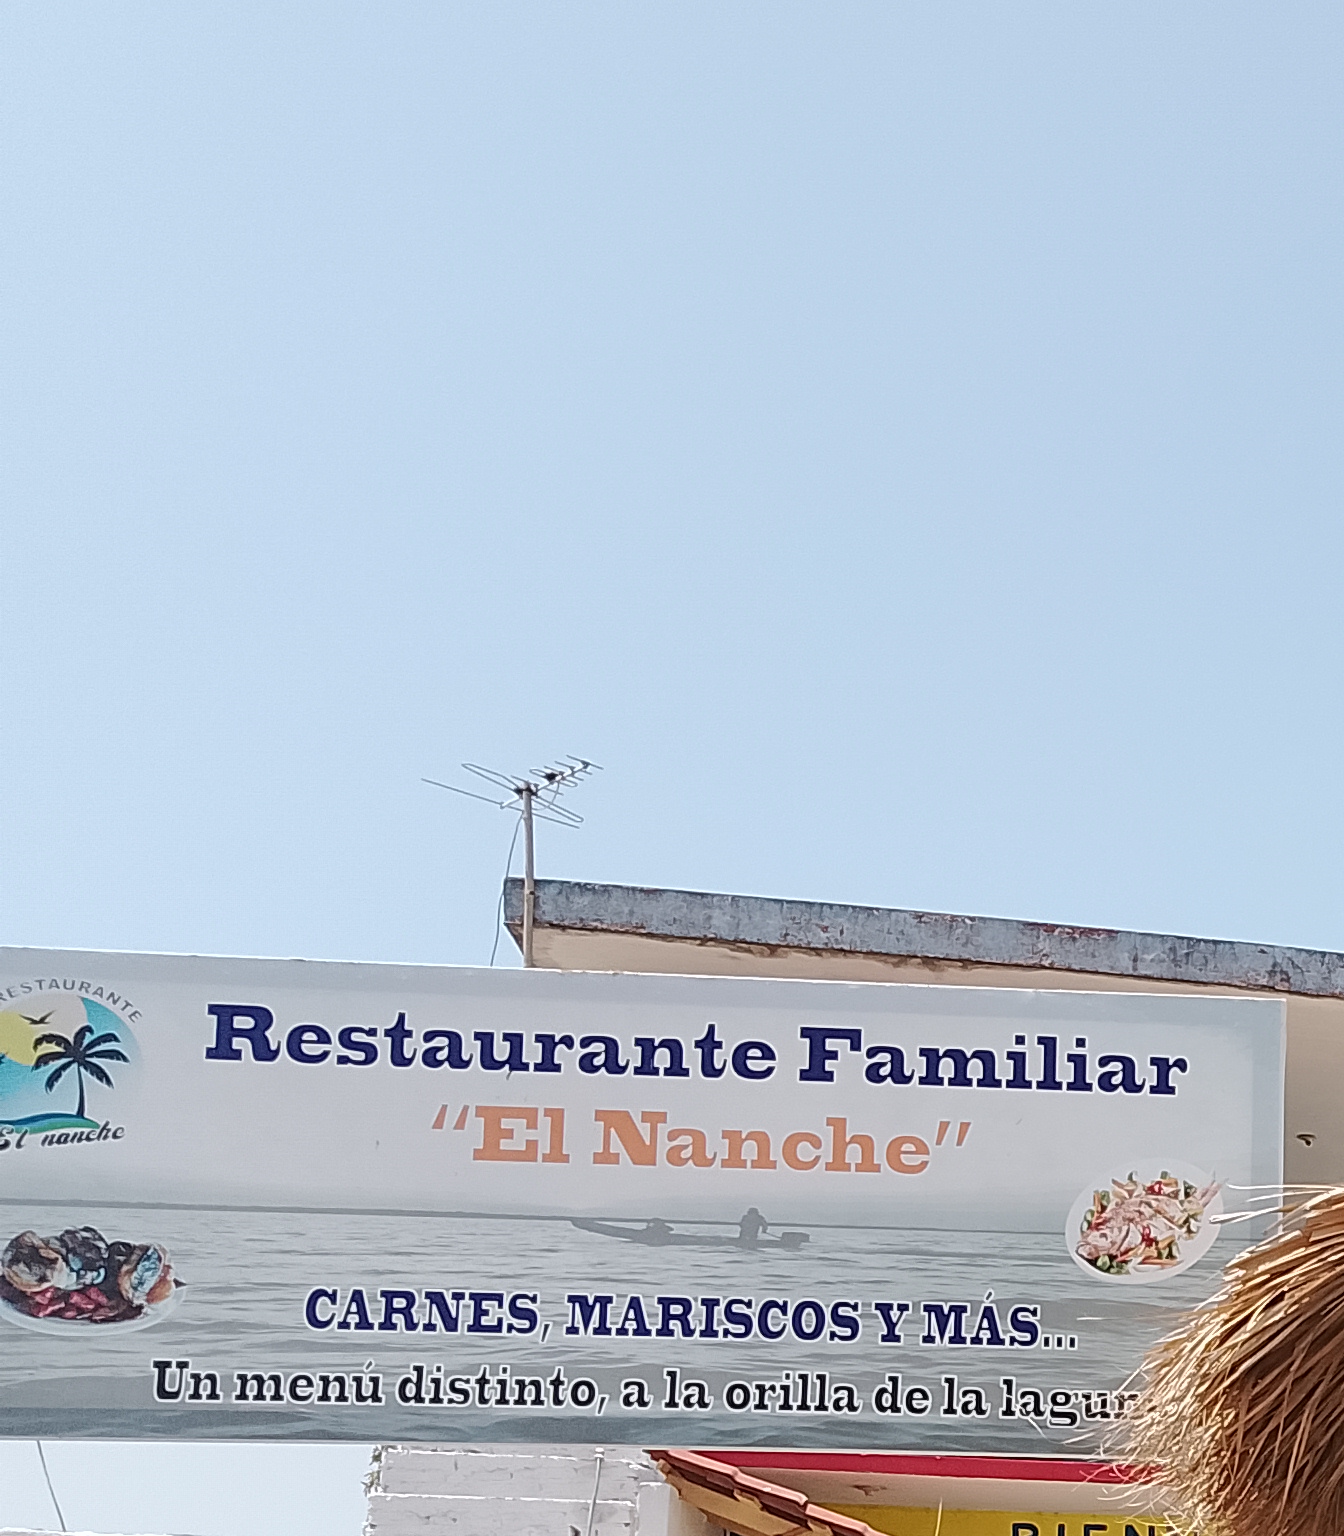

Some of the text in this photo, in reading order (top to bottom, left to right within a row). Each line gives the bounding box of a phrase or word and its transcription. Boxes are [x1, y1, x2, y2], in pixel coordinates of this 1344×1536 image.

[204, 1003, 1189, 1096] Restaurante Familiar
[41, 1120, 126, 1148] nanche
[303, 1288, 1078, 1351] CARNES, MARISCOS Y MÁS...
[153, 1361, 1141, 1427] Un menú distinto, a la orilla de la lagu
